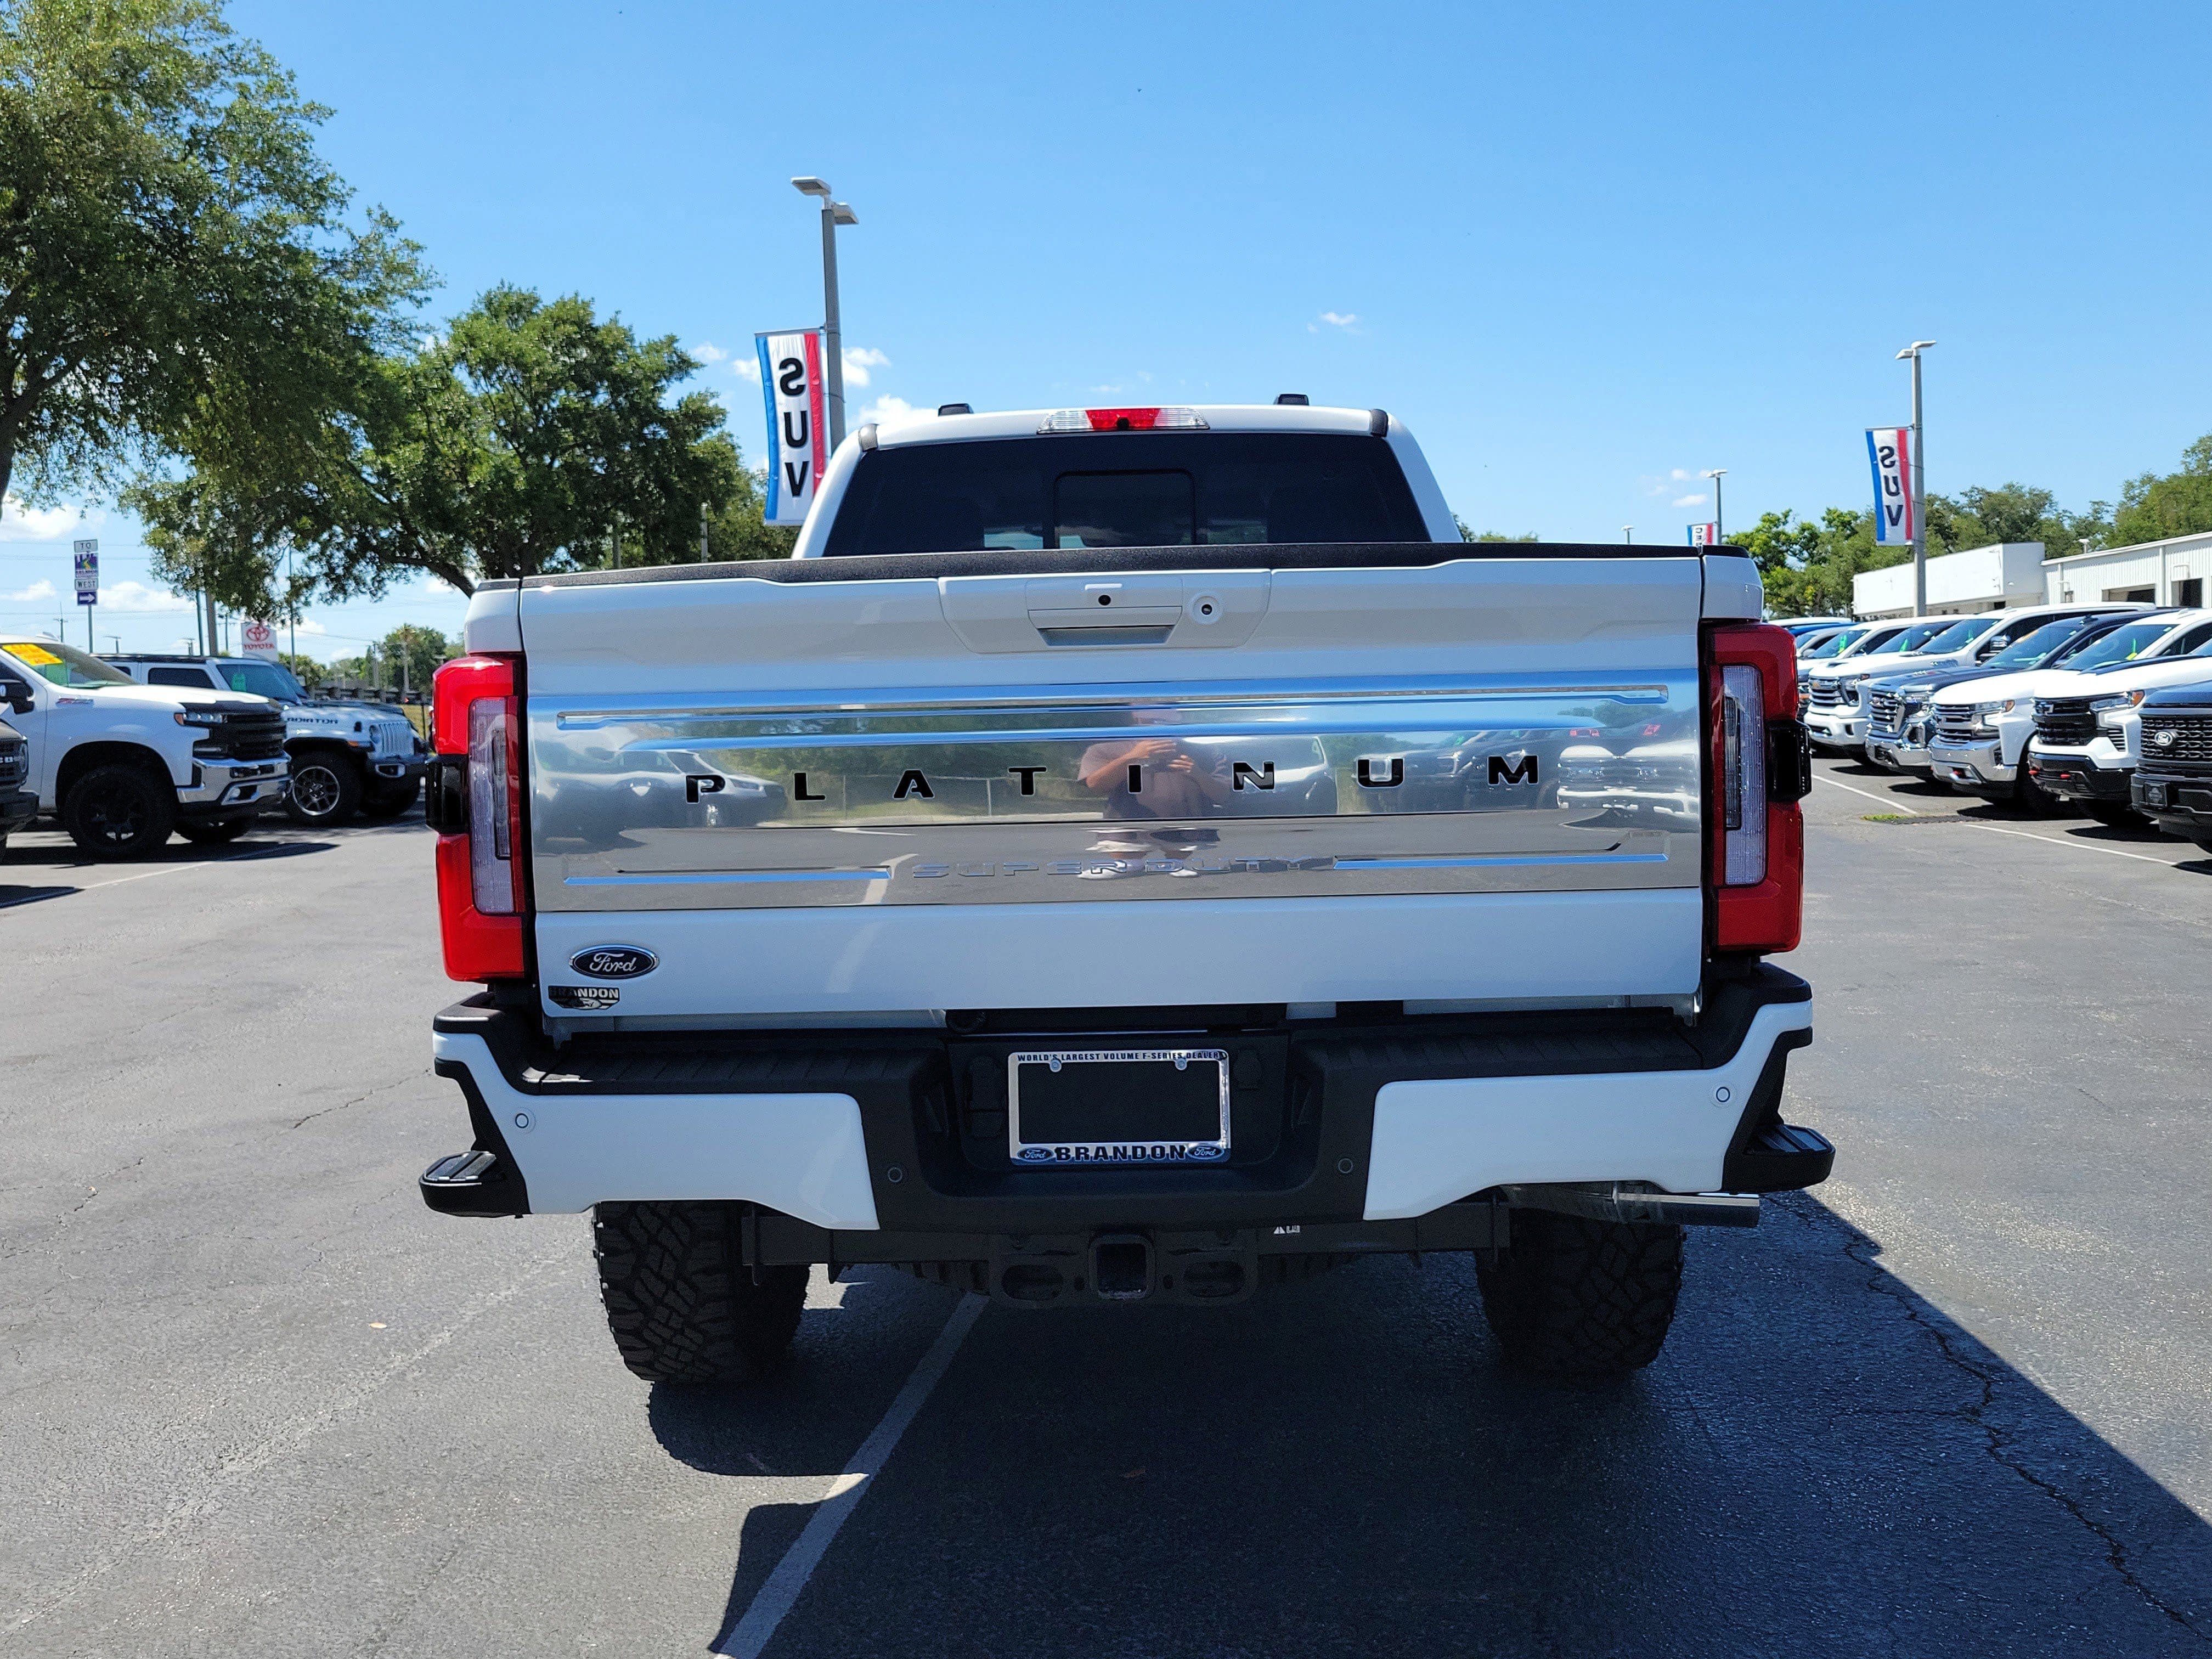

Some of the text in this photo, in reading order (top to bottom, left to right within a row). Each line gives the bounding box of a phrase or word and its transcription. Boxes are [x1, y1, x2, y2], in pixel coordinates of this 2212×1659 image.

[686, 755, 1538, 803] PLATINUM
[913, 856, 1312, 878] SUPER DUTY
[589, 952, 637, 972] Ford
[550, 987, 619, 998] NDON
[1025, 1145, 1216, 1161] Ford BRANDON Ford
